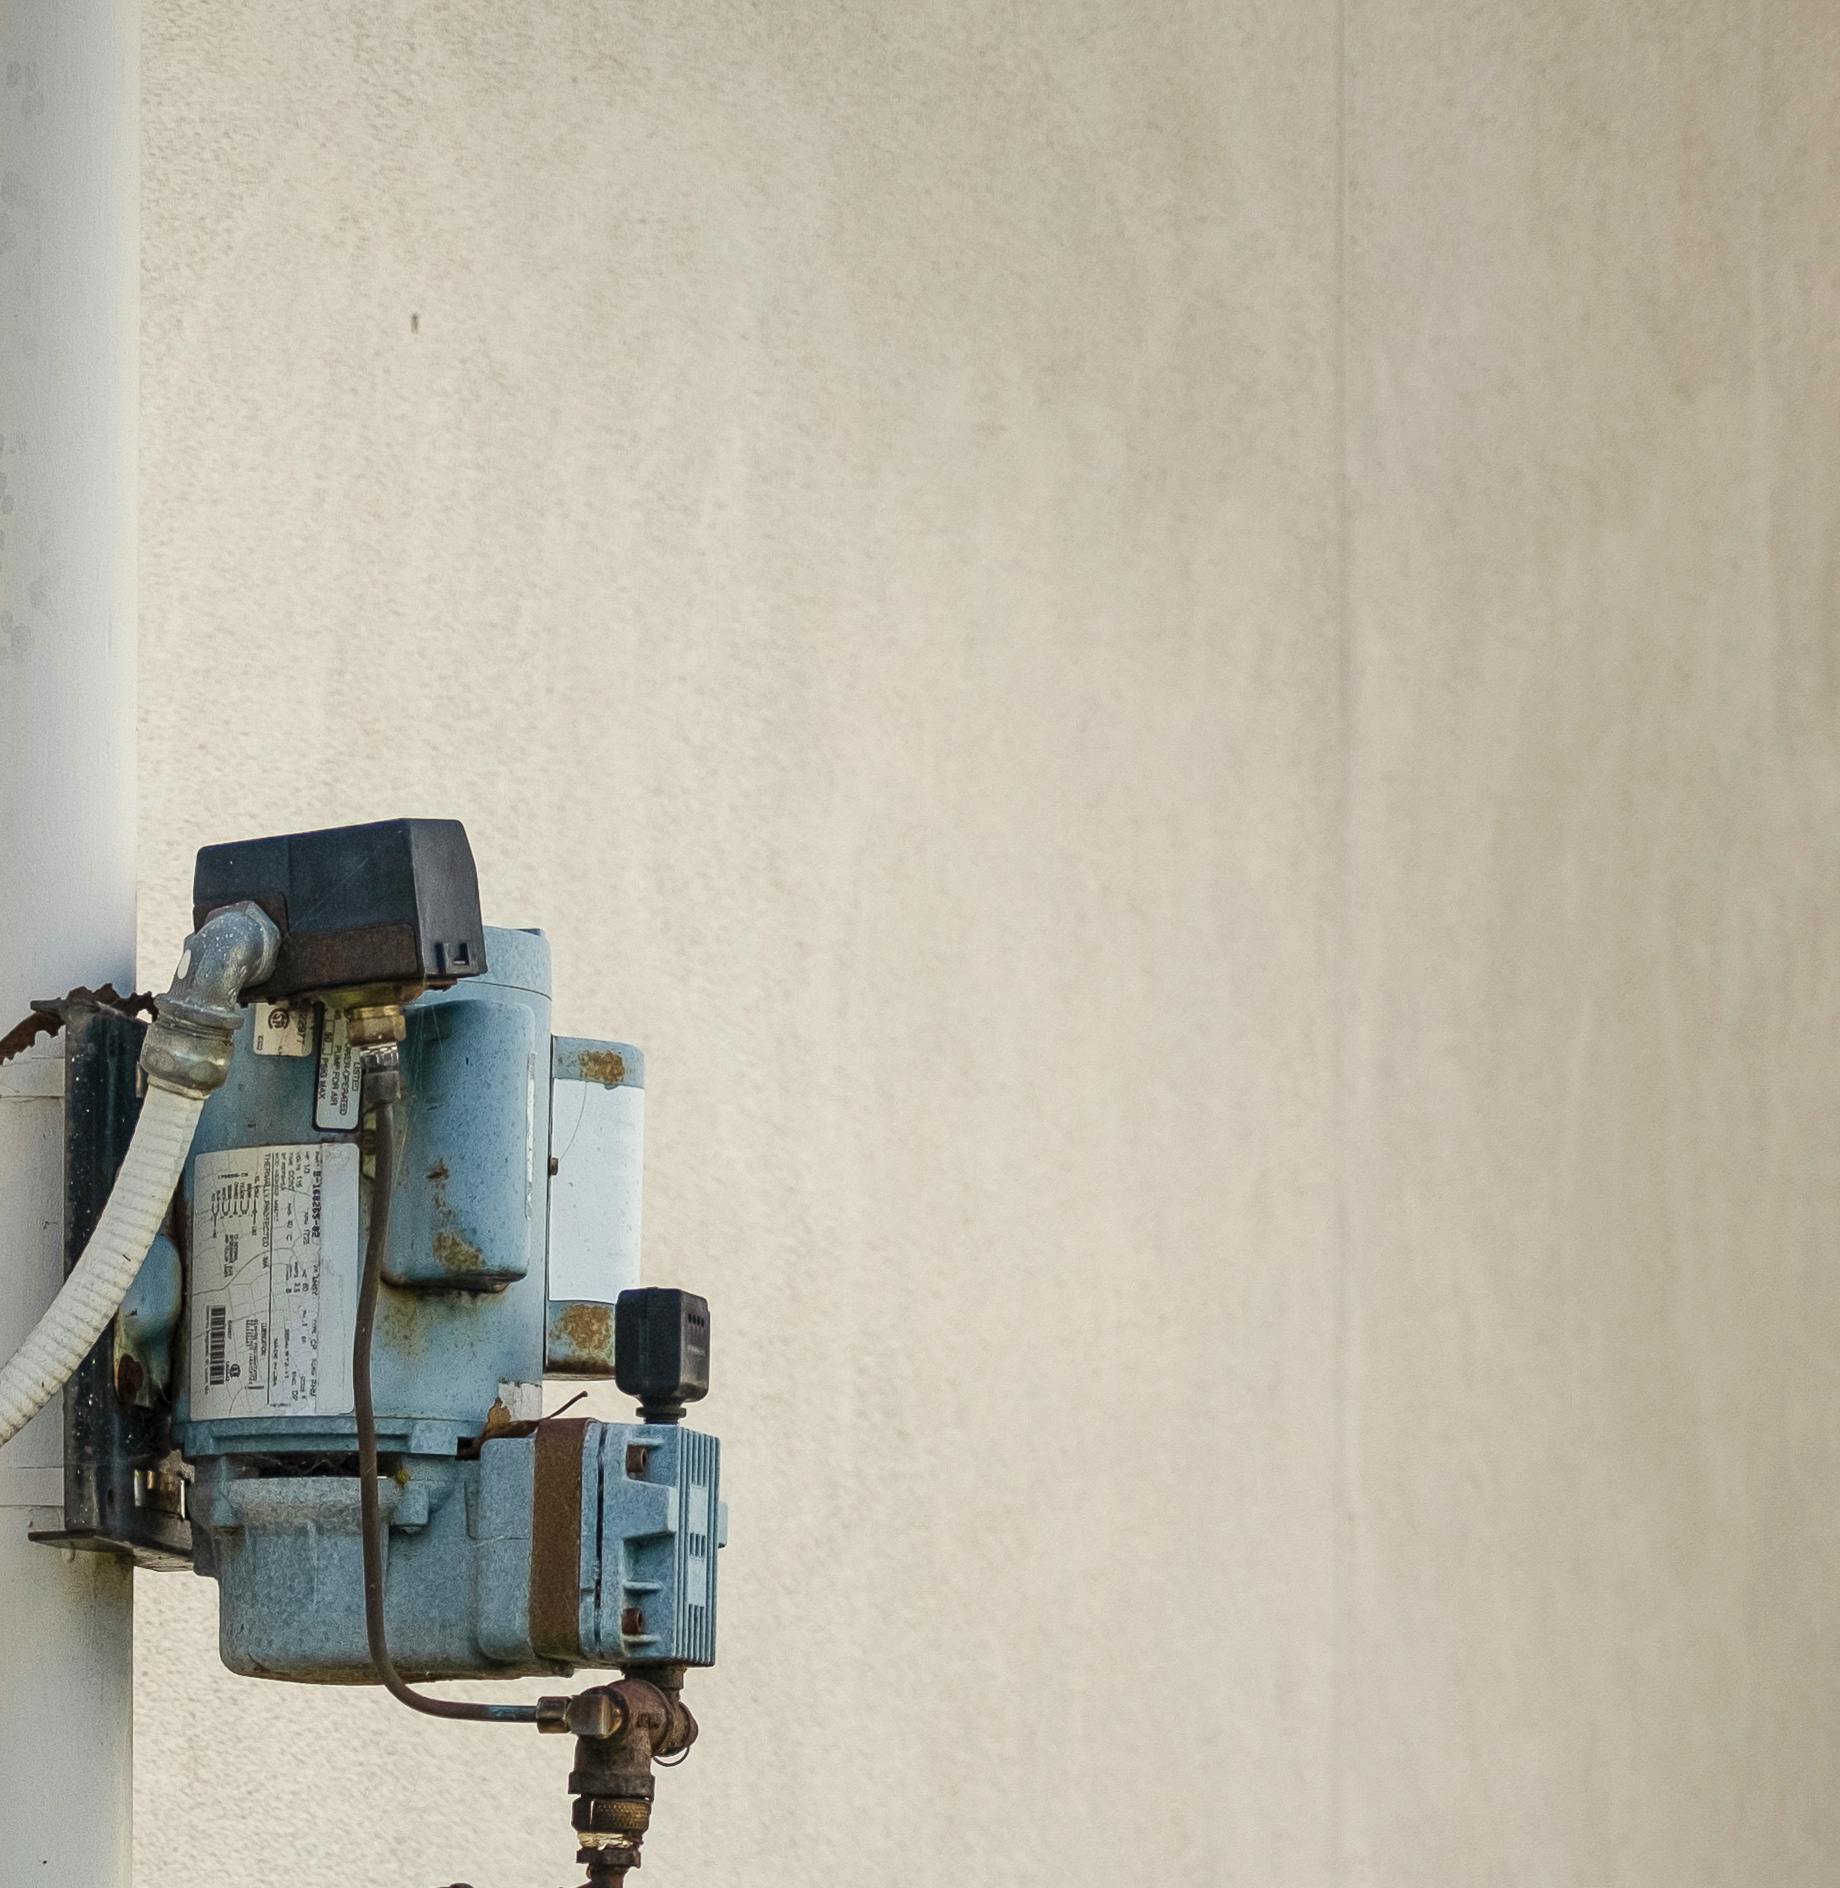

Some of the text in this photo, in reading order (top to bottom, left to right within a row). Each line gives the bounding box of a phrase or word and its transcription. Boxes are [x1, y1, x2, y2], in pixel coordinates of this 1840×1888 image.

[332, 1072, 340, 1090] FOR
[340, 1043, 351, 1115] OWER-OPERATED
[319, 1080, 327, 1099] MAX
[330, 1092, 338, 1105] AIR
